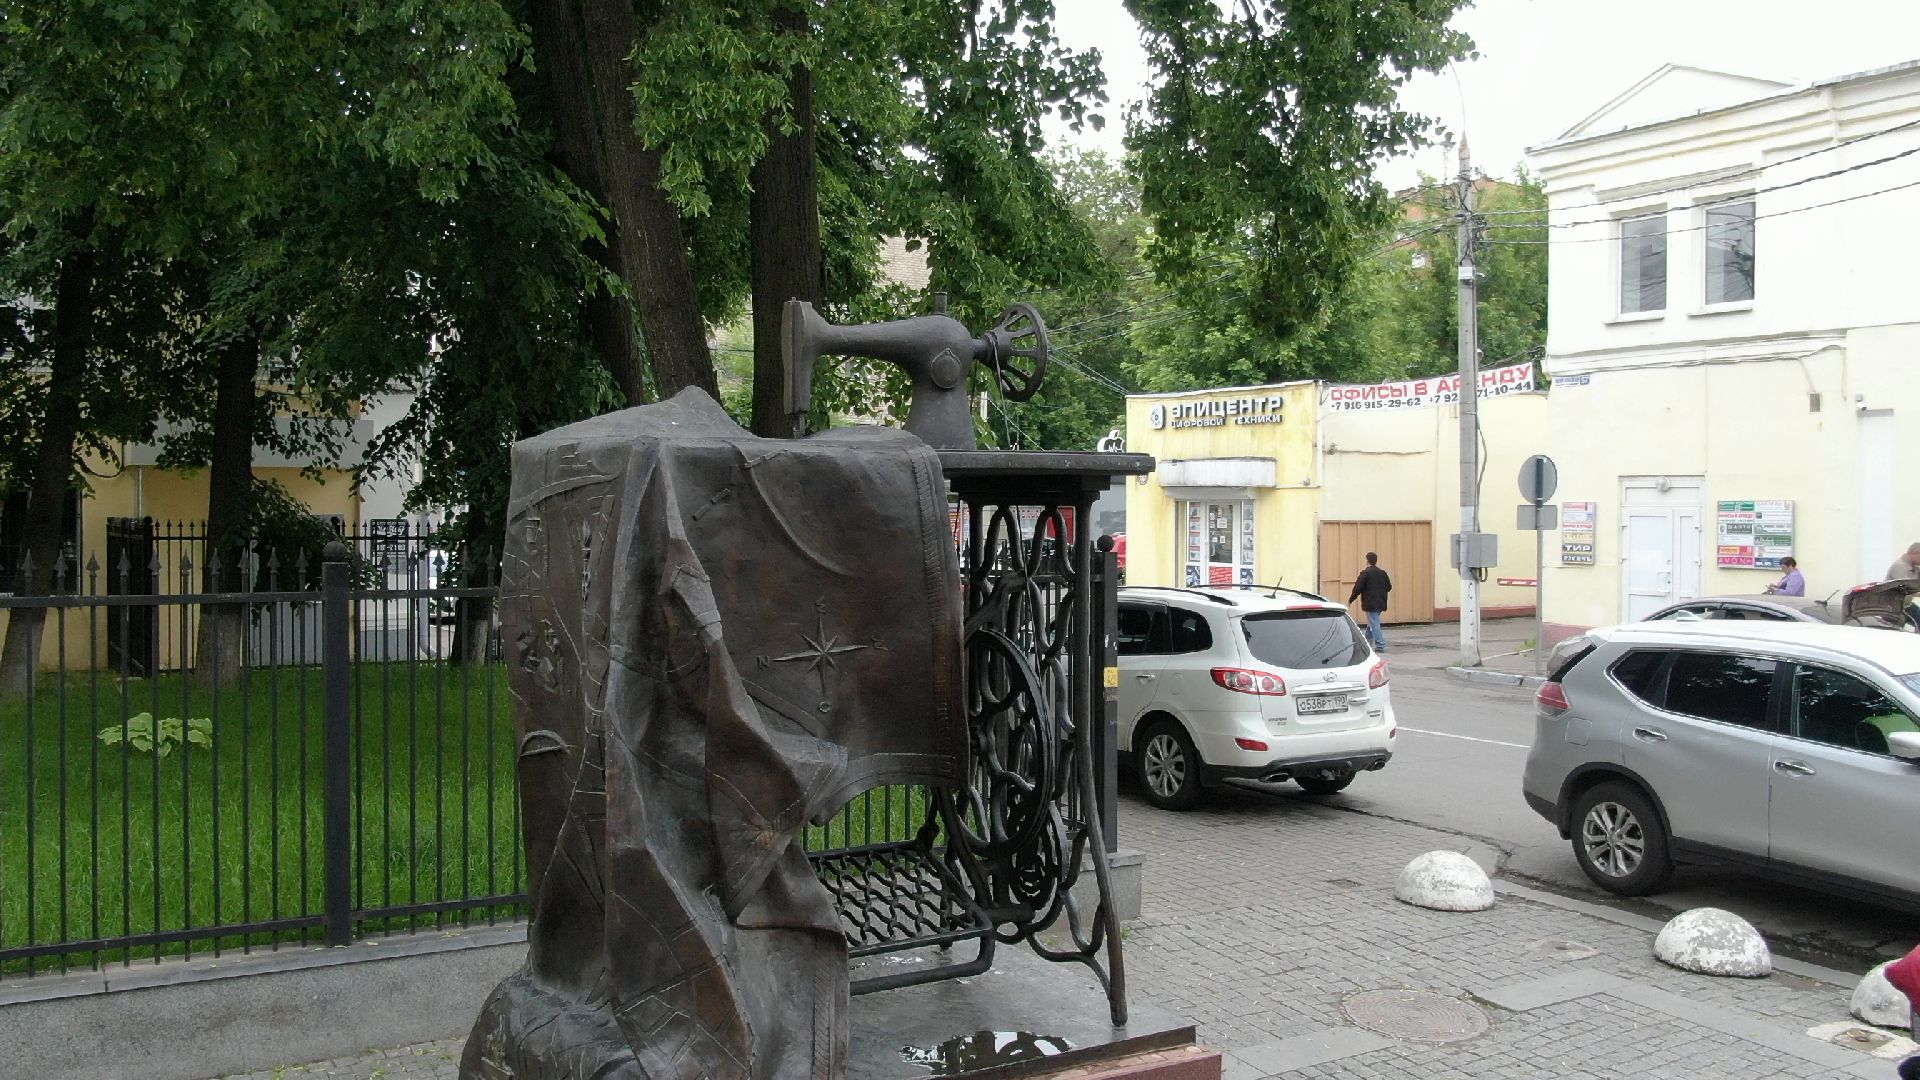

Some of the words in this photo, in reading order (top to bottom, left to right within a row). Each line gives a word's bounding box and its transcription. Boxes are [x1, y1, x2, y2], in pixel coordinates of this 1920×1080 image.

[1331, 385, 1408, 401] ОФИСЫ
[1414, 383, 1428, 396] В
[1437, 366, 1531, 394] АРНДУ
[1172, 396, 1283, 418] ЭПИЦЕНТР
[1364, 397, 1421, 409] 915-29-62
[1171, 418, 1226, 428] ЦИФРОВОЙ
[1233, 414, 1283, 425] ТЕХНИКИ
